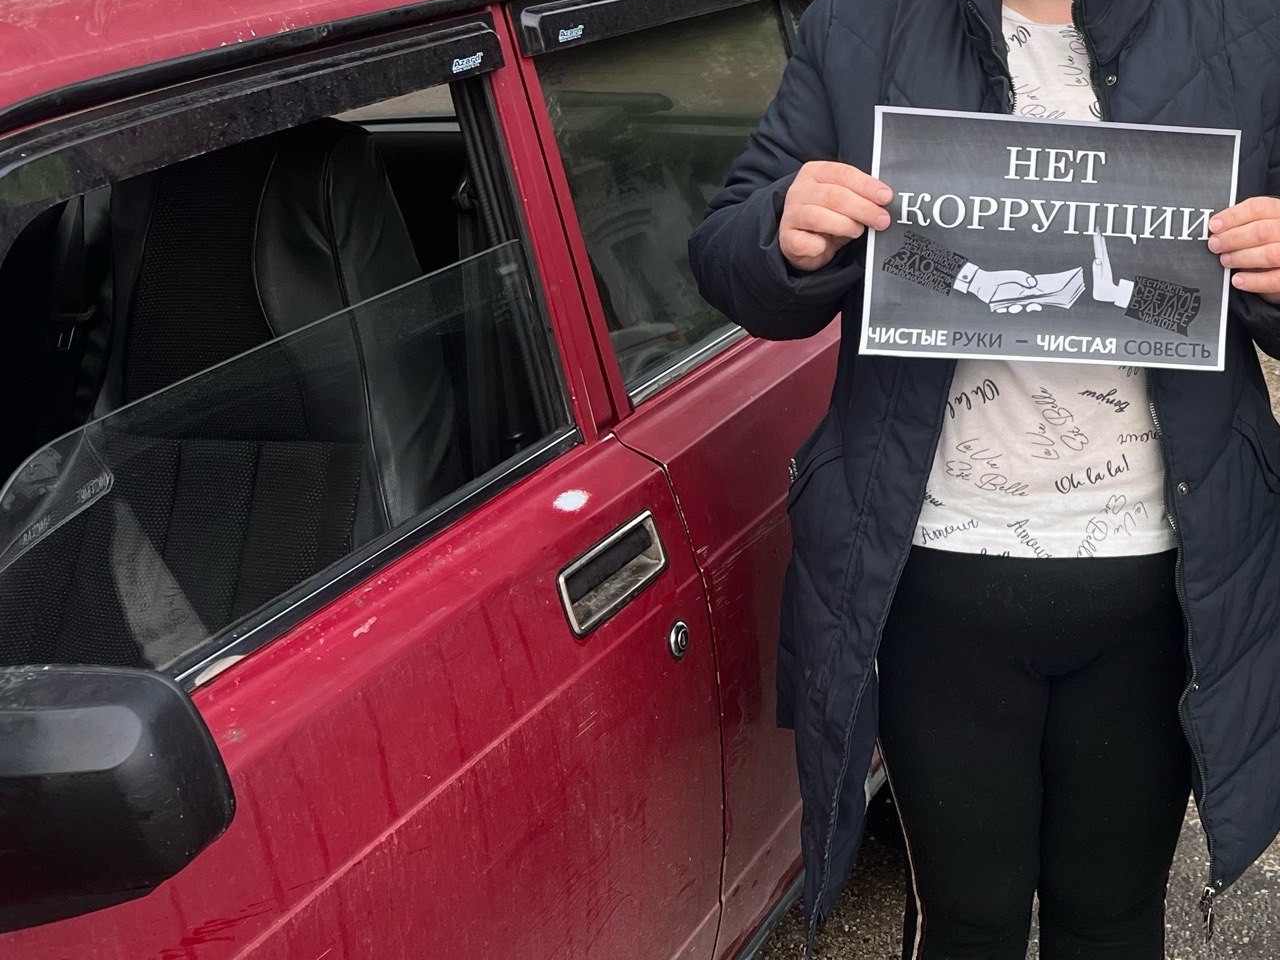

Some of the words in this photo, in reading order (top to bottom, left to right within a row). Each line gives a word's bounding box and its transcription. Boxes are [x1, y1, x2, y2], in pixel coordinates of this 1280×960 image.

[1004, 146, 1106, 184] НЕТ
[897, 192, 1214, 244] КОРРУПЦИИ
[895, 248, 934, 273] ЗЛО
[1134, 284, 1200, 315] СВЕТЛОЕ
[1136, 276, 1185, 296] ЧЕСТНОСТЬ
[1130, 297, 1192, 327] БУДУЩЕЕ
[1139, 311, 1178, 332] ЧИСТОТА
[868, 327, 948, 347] ЧИСТЫЕ
[952, 330, 1003, 350] РУКИ
[1036, 335, 1117, 355] ЧИСТАЯ
[1124, 339, 1212, 359] СОВЕСТЬ
[974, 473, 1029, 496] Belle
[1055, 473, 1085, 494] Oh
[1086, 467, 1105, 484] la
